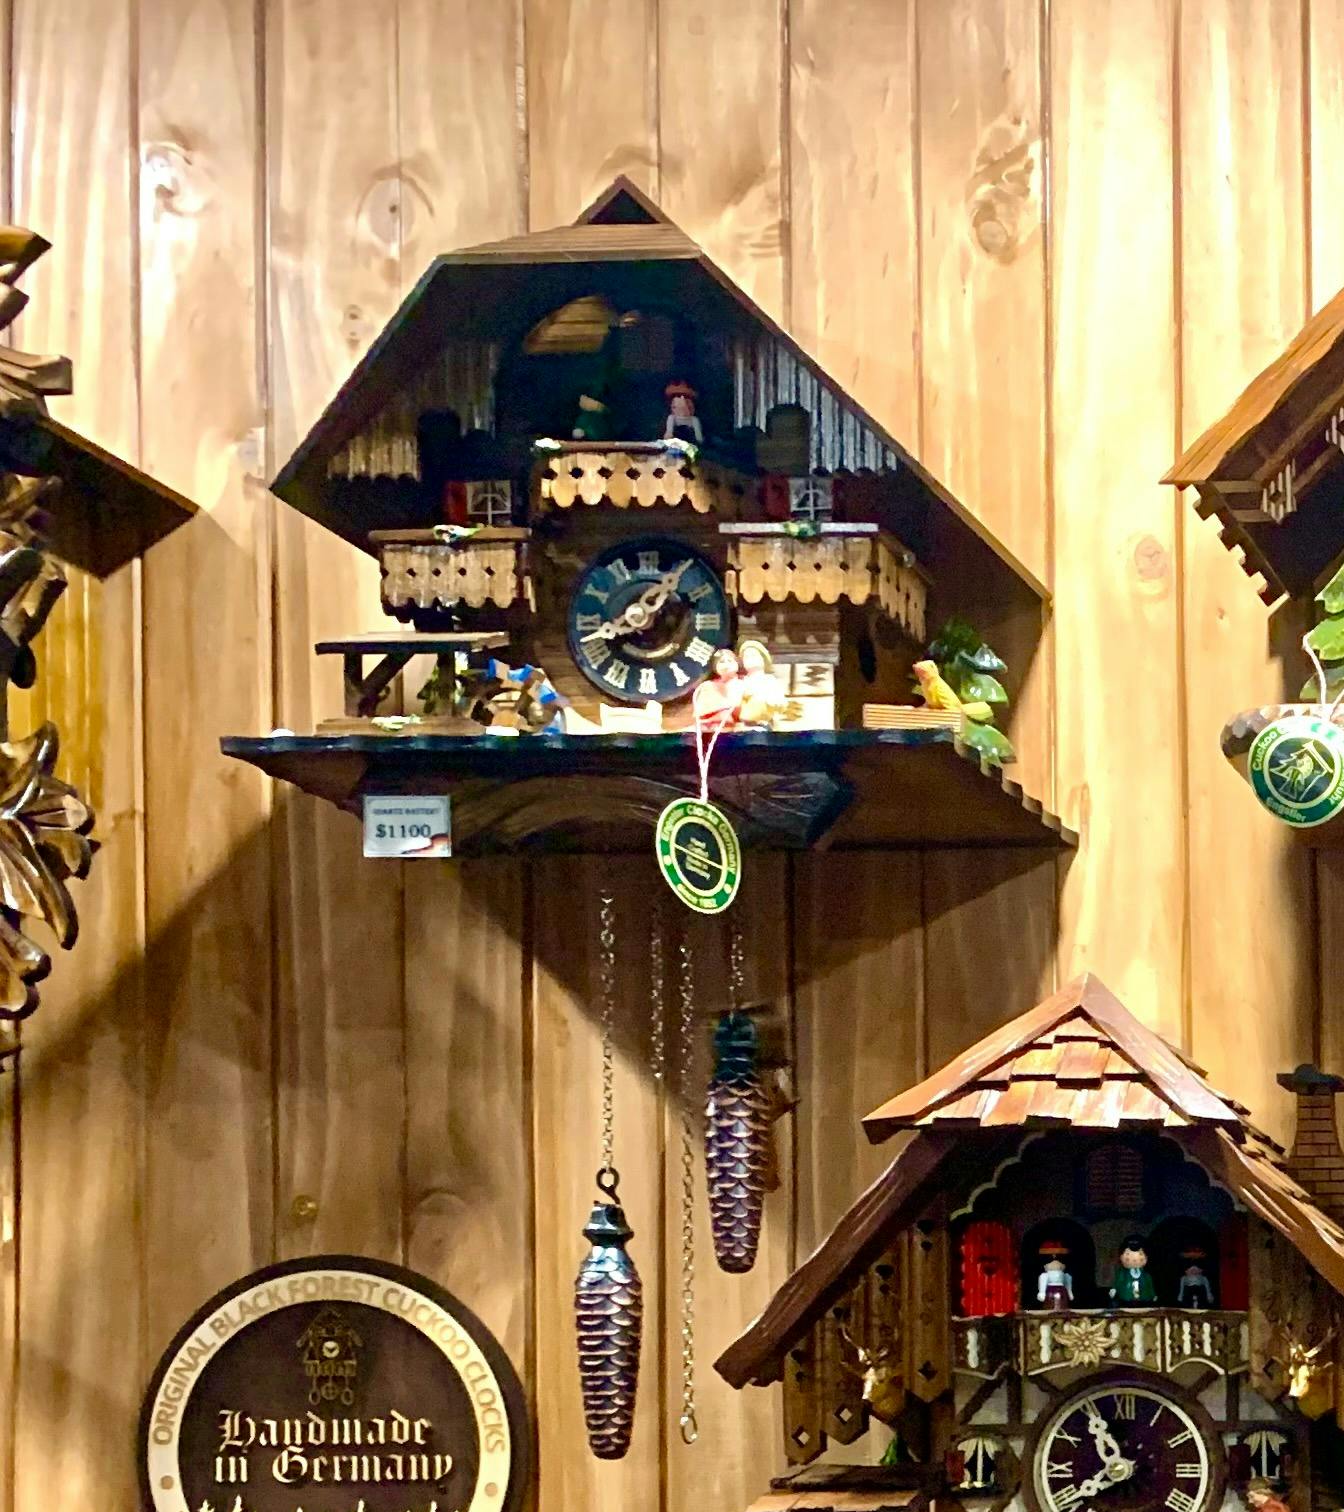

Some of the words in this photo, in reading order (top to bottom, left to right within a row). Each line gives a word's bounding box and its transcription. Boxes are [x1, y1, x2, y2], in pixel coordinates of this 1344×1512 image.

[1253, 730, 1278, 771] Cuckoo
[376, 822, 431, 838] $1100
[153, 1338, 217, 1446] ORIGINAL
[209, 1288, 287, 1338] BLACK
[287, 1276, 382, 1302] FOREST
[382, 1288, 470, 1361] CUCKOO
[463, 1360, 507, 1454] CLOCKS
[220, 1410, 432, 1447] Handmade
[214, 1450, 248, 1483] in
[272, 1445, 453, 1484] Germany
